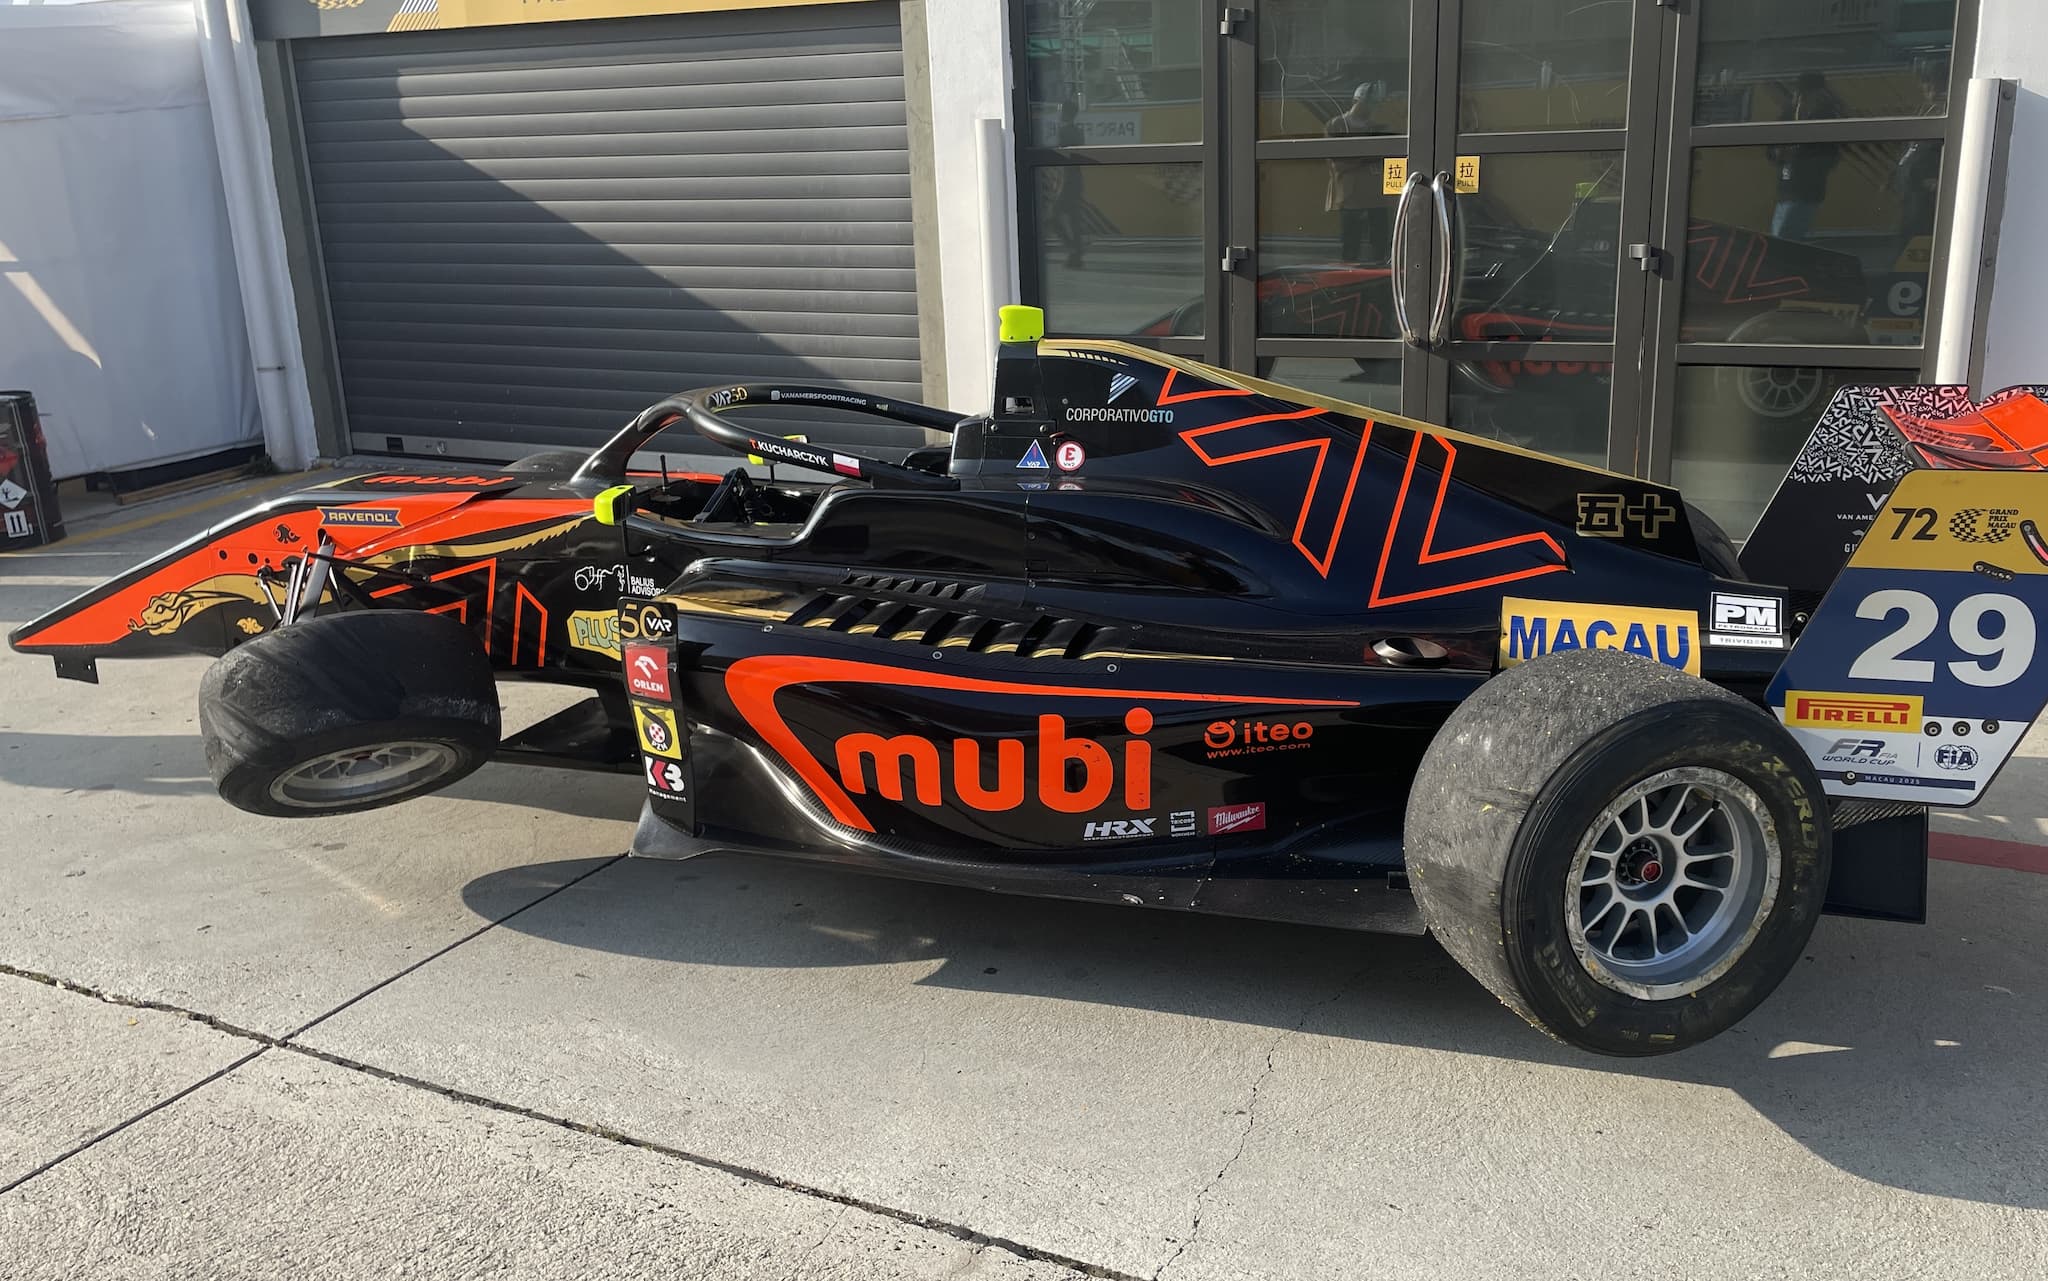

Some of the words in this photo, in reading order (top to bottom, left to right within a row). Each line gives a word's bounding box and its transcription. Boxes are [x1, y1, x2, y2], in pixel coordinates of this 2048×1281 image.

[1388, 164, 1403, 179] 拉
[1460, 162, 1475, 178] 拉
[1066, 407, 1174, 424] CORPORATIVOGTO
[1065, 447, 1076, 461] E
[329, 511, 393, 523] RAVENOL
[1989, 508, 2019, 516] GRAND
[1891, 507, 1938, 541] 72
[631, 575, 655, 587] BALIUS
[1715, 603, 1777, 627] PM
[1847, 589, 2037, 688] 29
[633, 678, 665, 693] ORLEN
[1796, 698, 1910, 725] PIRELLI
[1243, 721, 1314, 744] iteo
[1206, 743, 1311, 759] www.iteo.com
[835, 707, 1154, 814] mubi
[1822, 755, 1867, 764] WORLD
[1868, 758, 1896, 767] CUP
[1864, 775, 1896, 783] MACAU
[1213, 805, 1261, 828] Milwaukee
[1084, 817, 1158, 838] HRX
